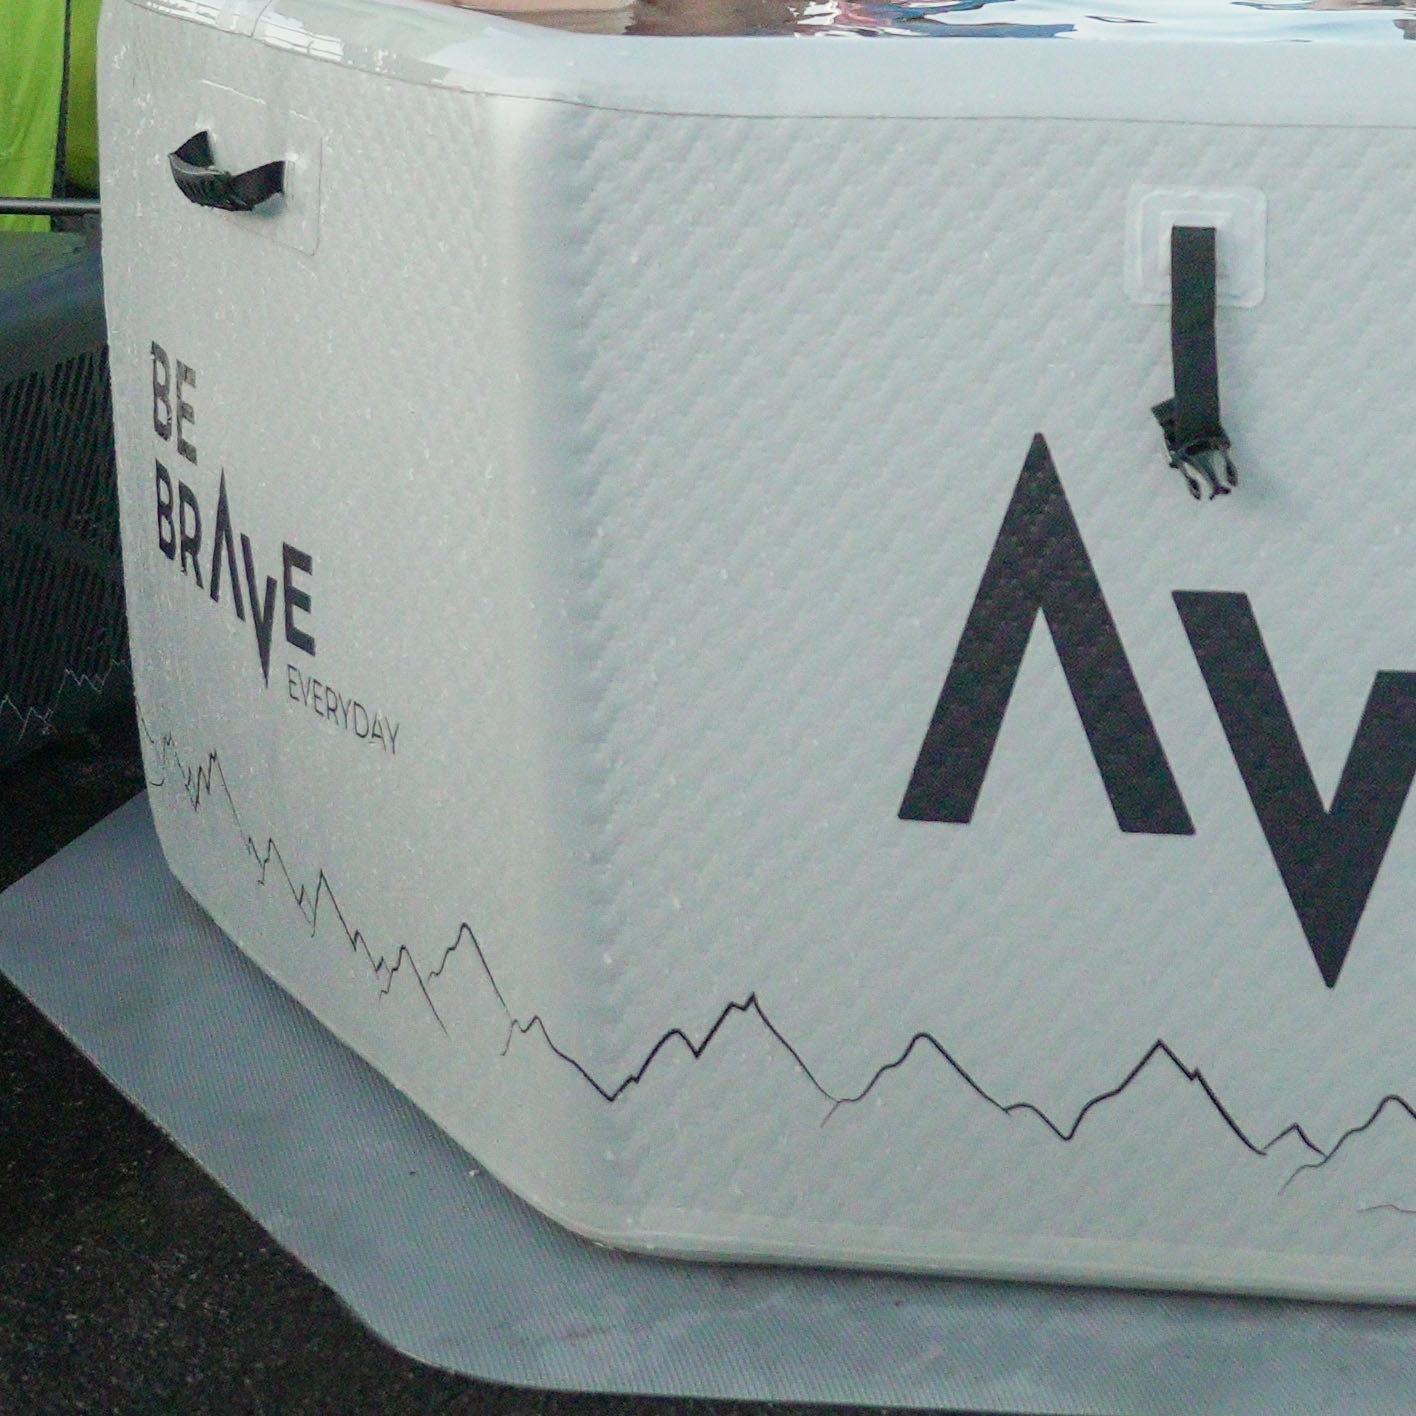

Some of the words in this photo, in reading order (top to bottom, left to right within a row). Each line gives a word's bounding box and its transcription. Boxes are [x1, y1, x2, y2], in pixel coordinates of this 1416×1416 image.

[151, 340, 198, 466] BE
[155, 457, 316, 688] BRAVE
[286, 663, 402, 754] EVERYDAY
